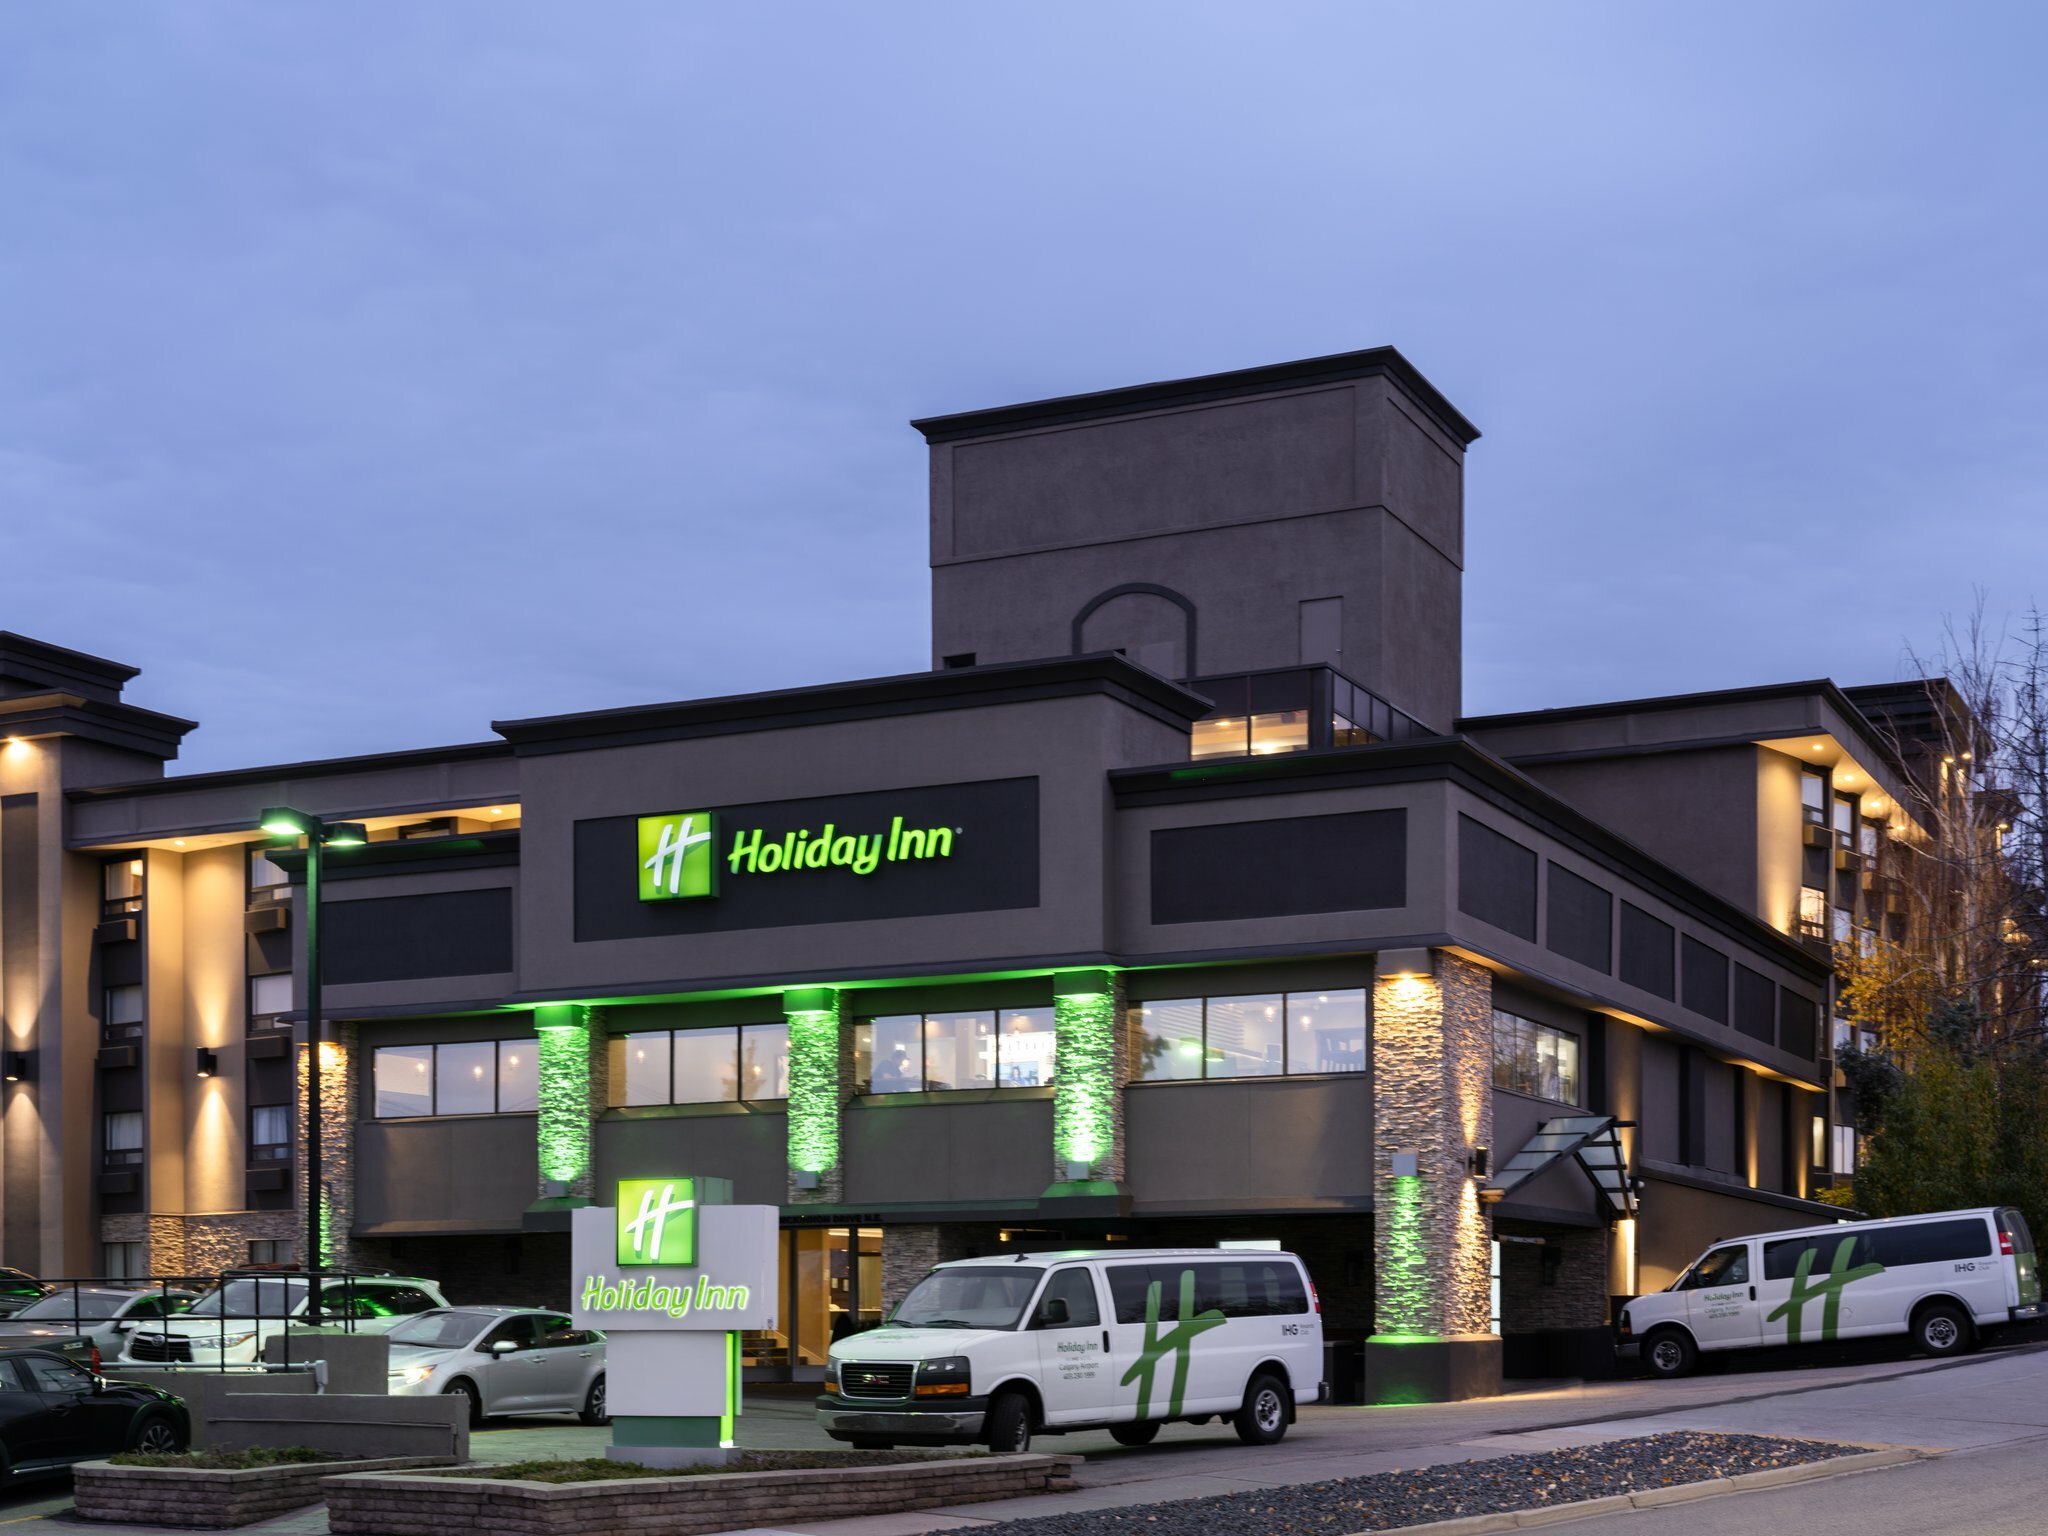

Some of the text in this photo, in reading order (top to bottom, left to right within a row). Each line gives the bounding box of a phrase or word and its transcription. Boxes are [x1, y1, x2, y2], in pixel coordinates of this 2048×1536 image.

[727, 816, 953, 875] Holiday Inn
[1954, 1263, 1975, 1272] IHG
[581, 1275, 750, 1318] Holiday Inn
[1704, 1293, 1731, 1301] Holiday
[1281, 1324, 1299, 1336] IHG
[1057, 1340, 1098, 1353] Holiday Inn
